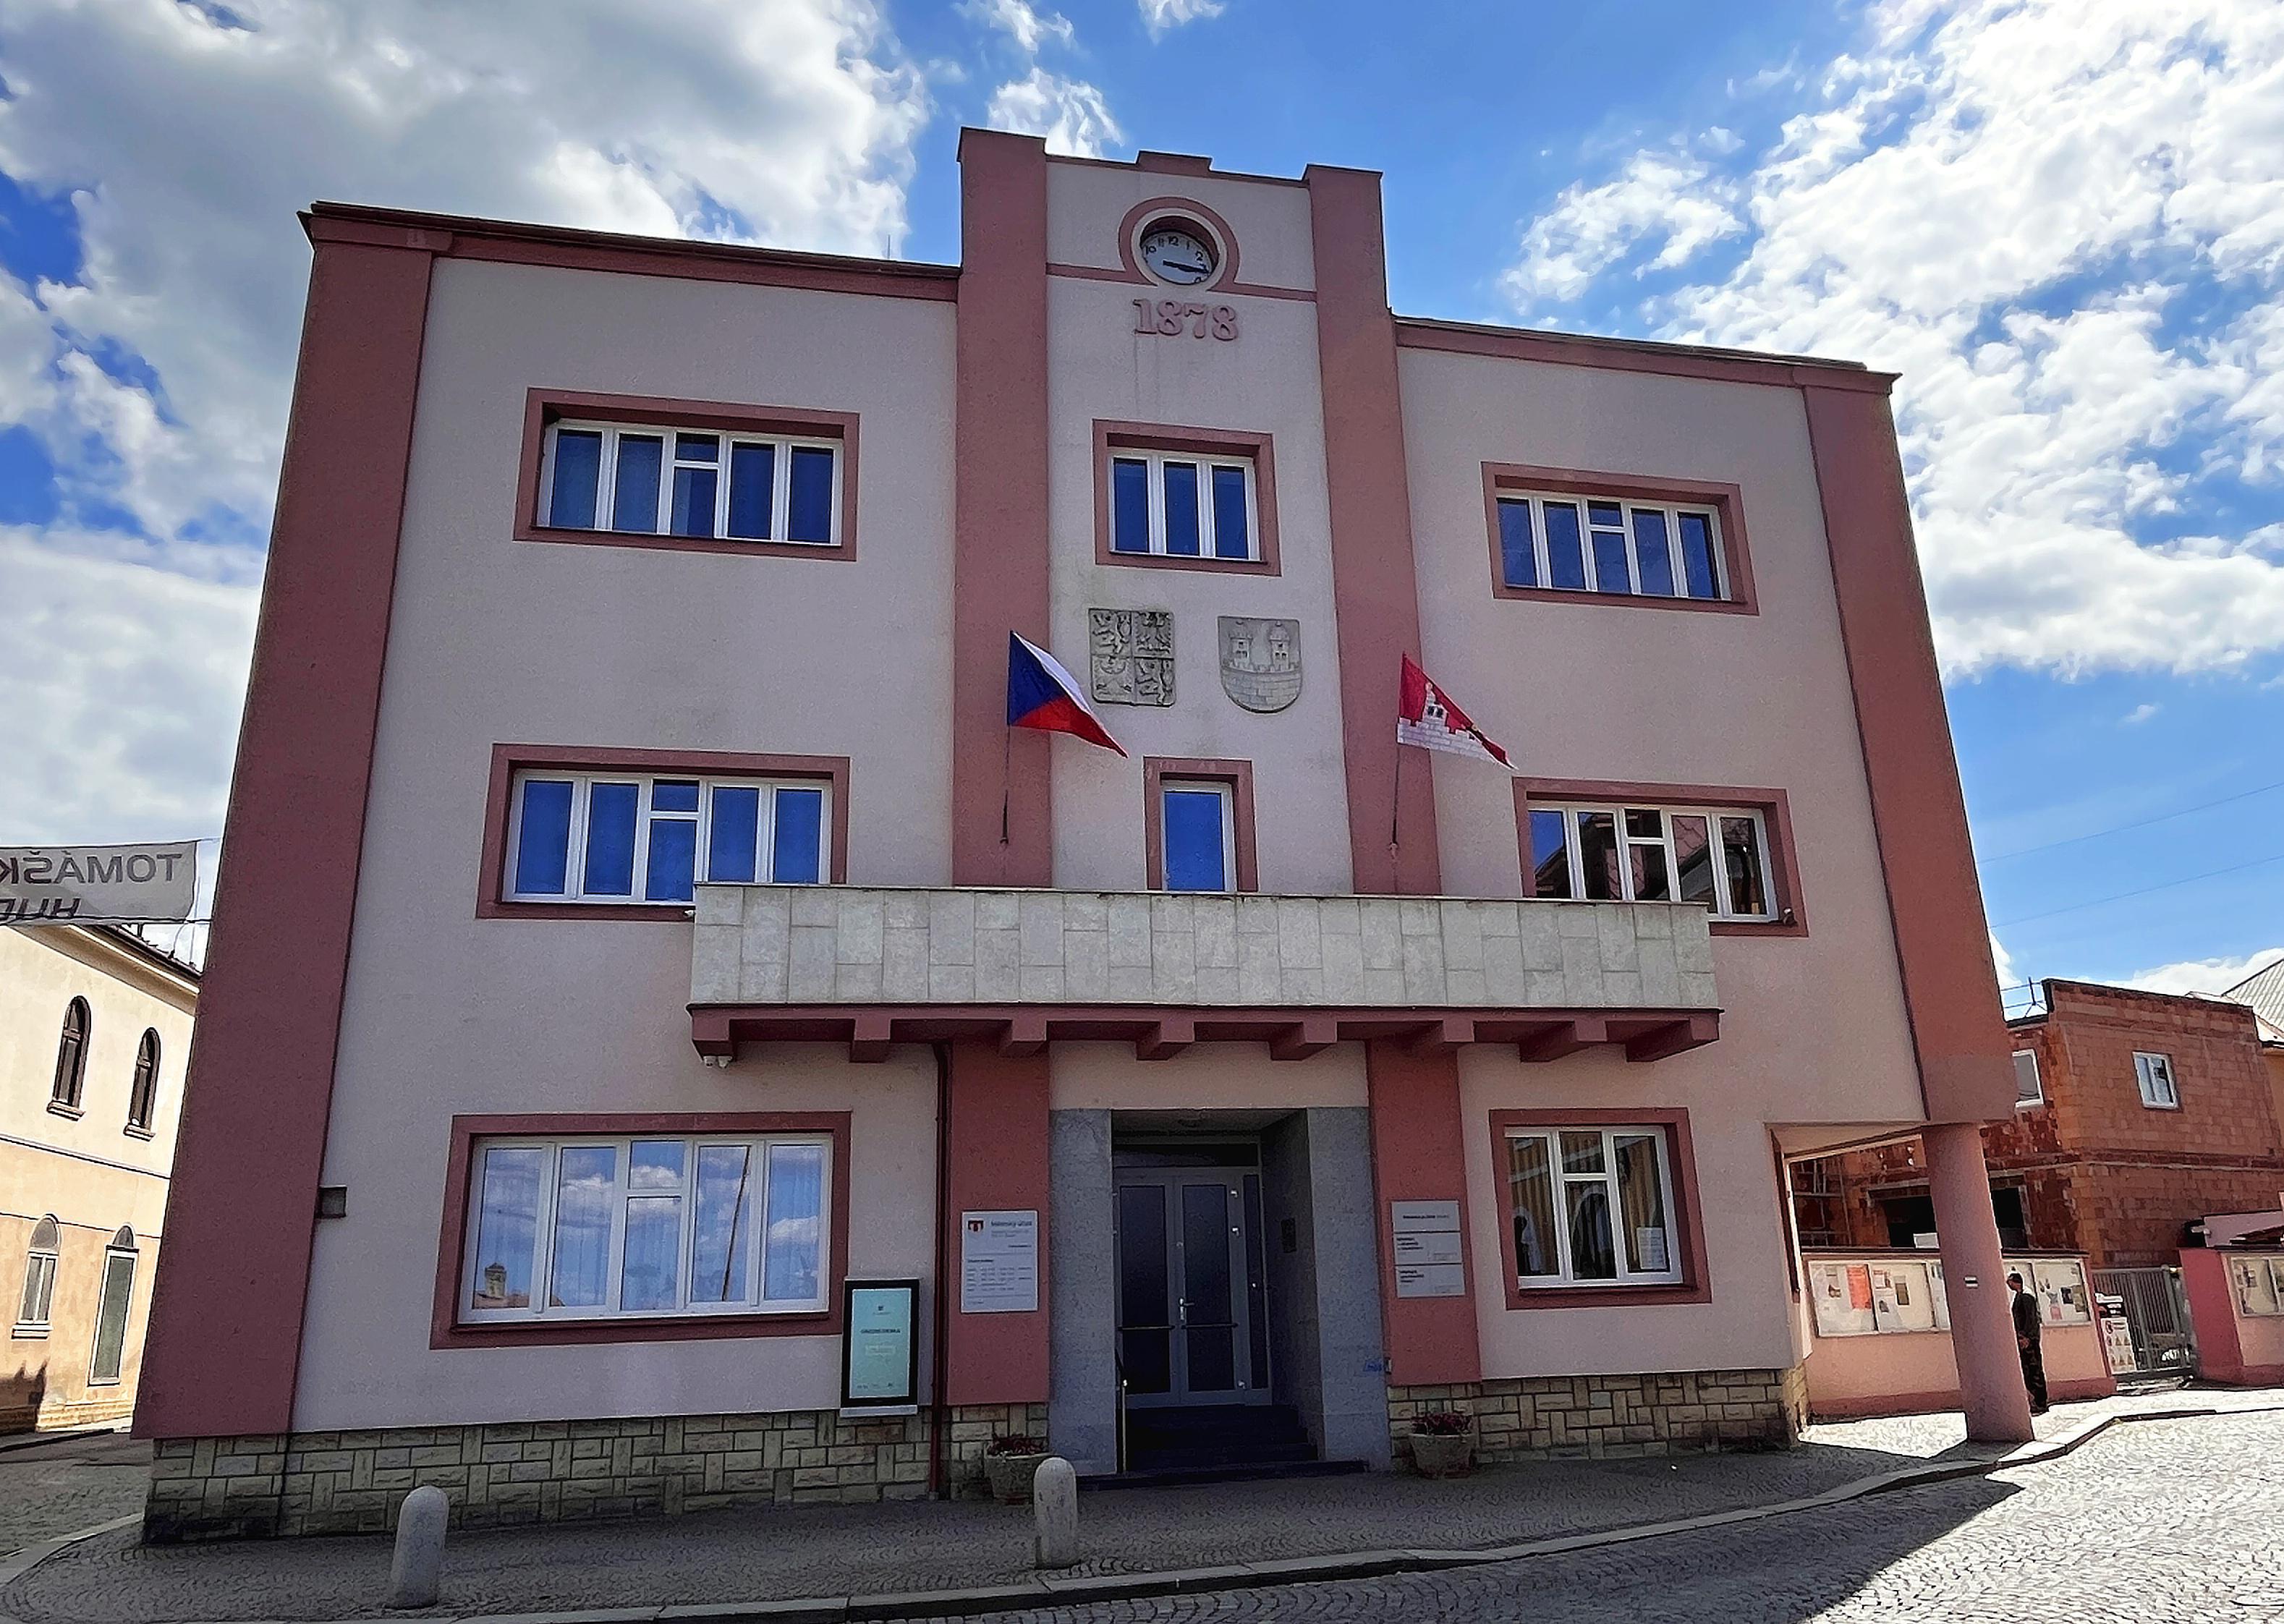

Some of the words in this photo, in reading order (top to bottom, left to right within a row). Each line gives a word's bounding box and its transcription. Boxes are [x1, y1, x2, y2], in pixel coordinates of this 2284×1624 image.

[1168, 236, 1179, 246] 12
[1145, 245, 1157, 255] 10
[1195, 250, 1203, 261] 2
[1133, 299, 1239, 341] 1878
